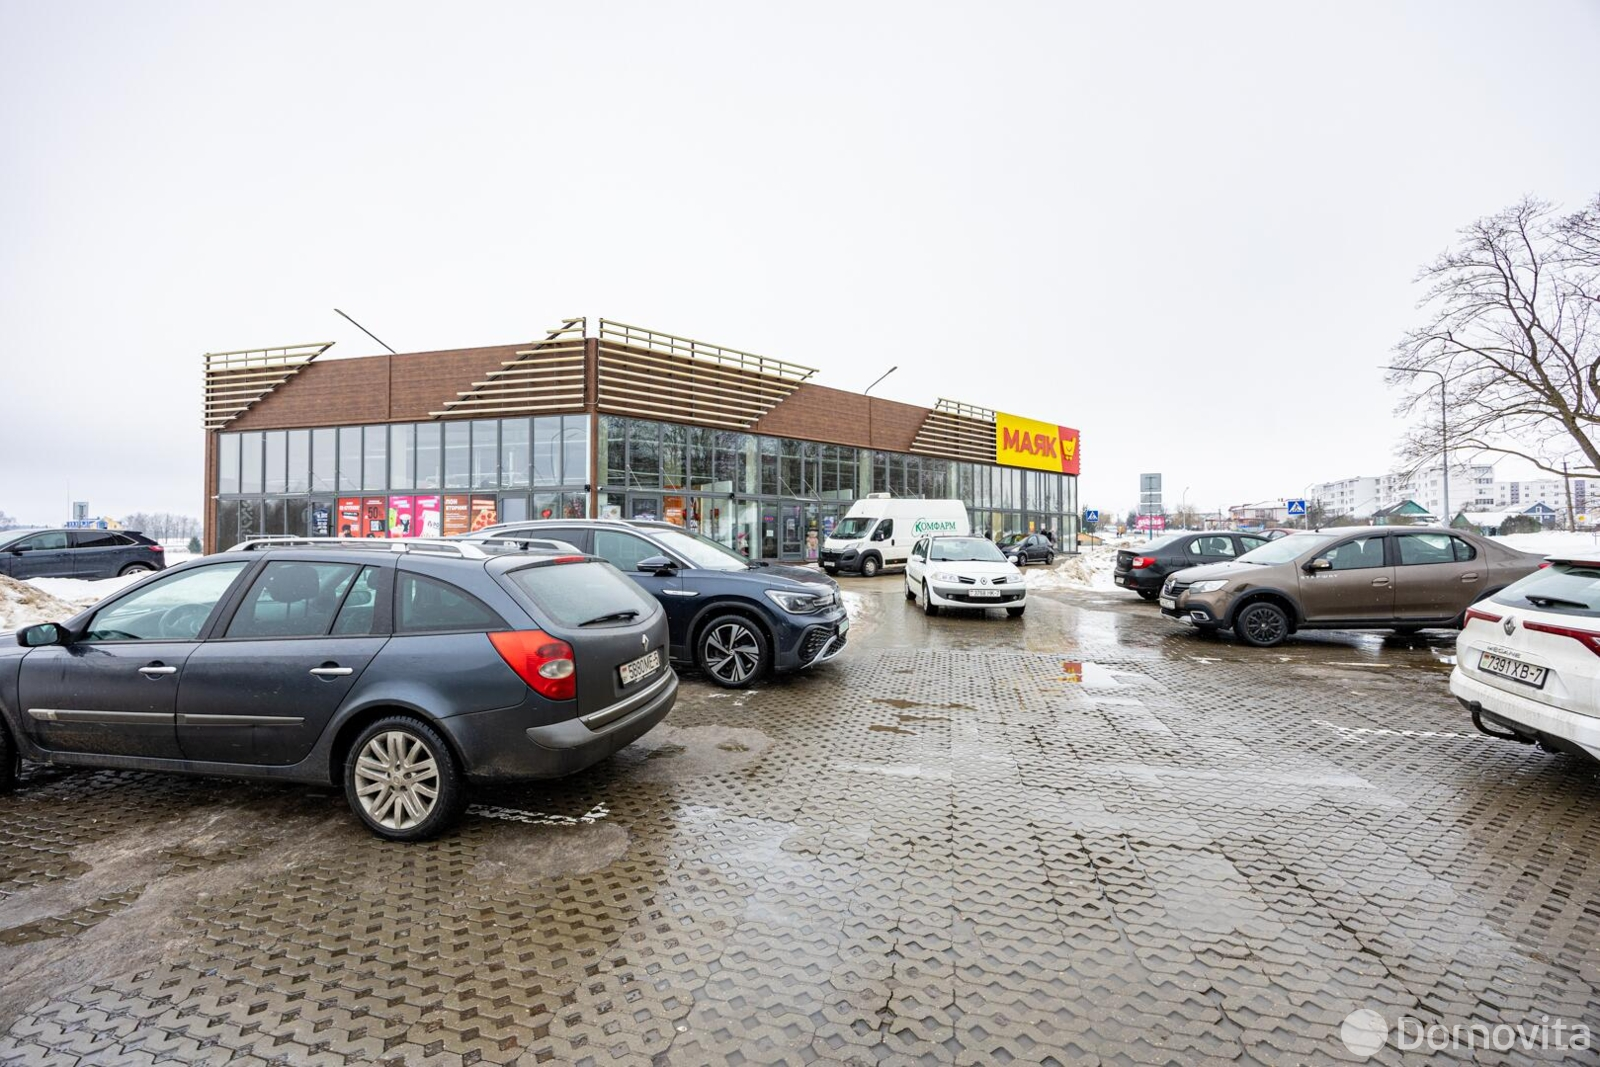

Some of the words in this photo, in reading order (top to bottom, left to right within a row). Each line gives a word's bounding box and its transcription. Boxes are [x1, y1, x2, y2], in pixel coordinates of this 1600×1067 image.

[1003, 427, 1057, 459] МАЯК
[367, 506, 379, 519] 50
[915, 521, 956, 533] КОМФАРМ
